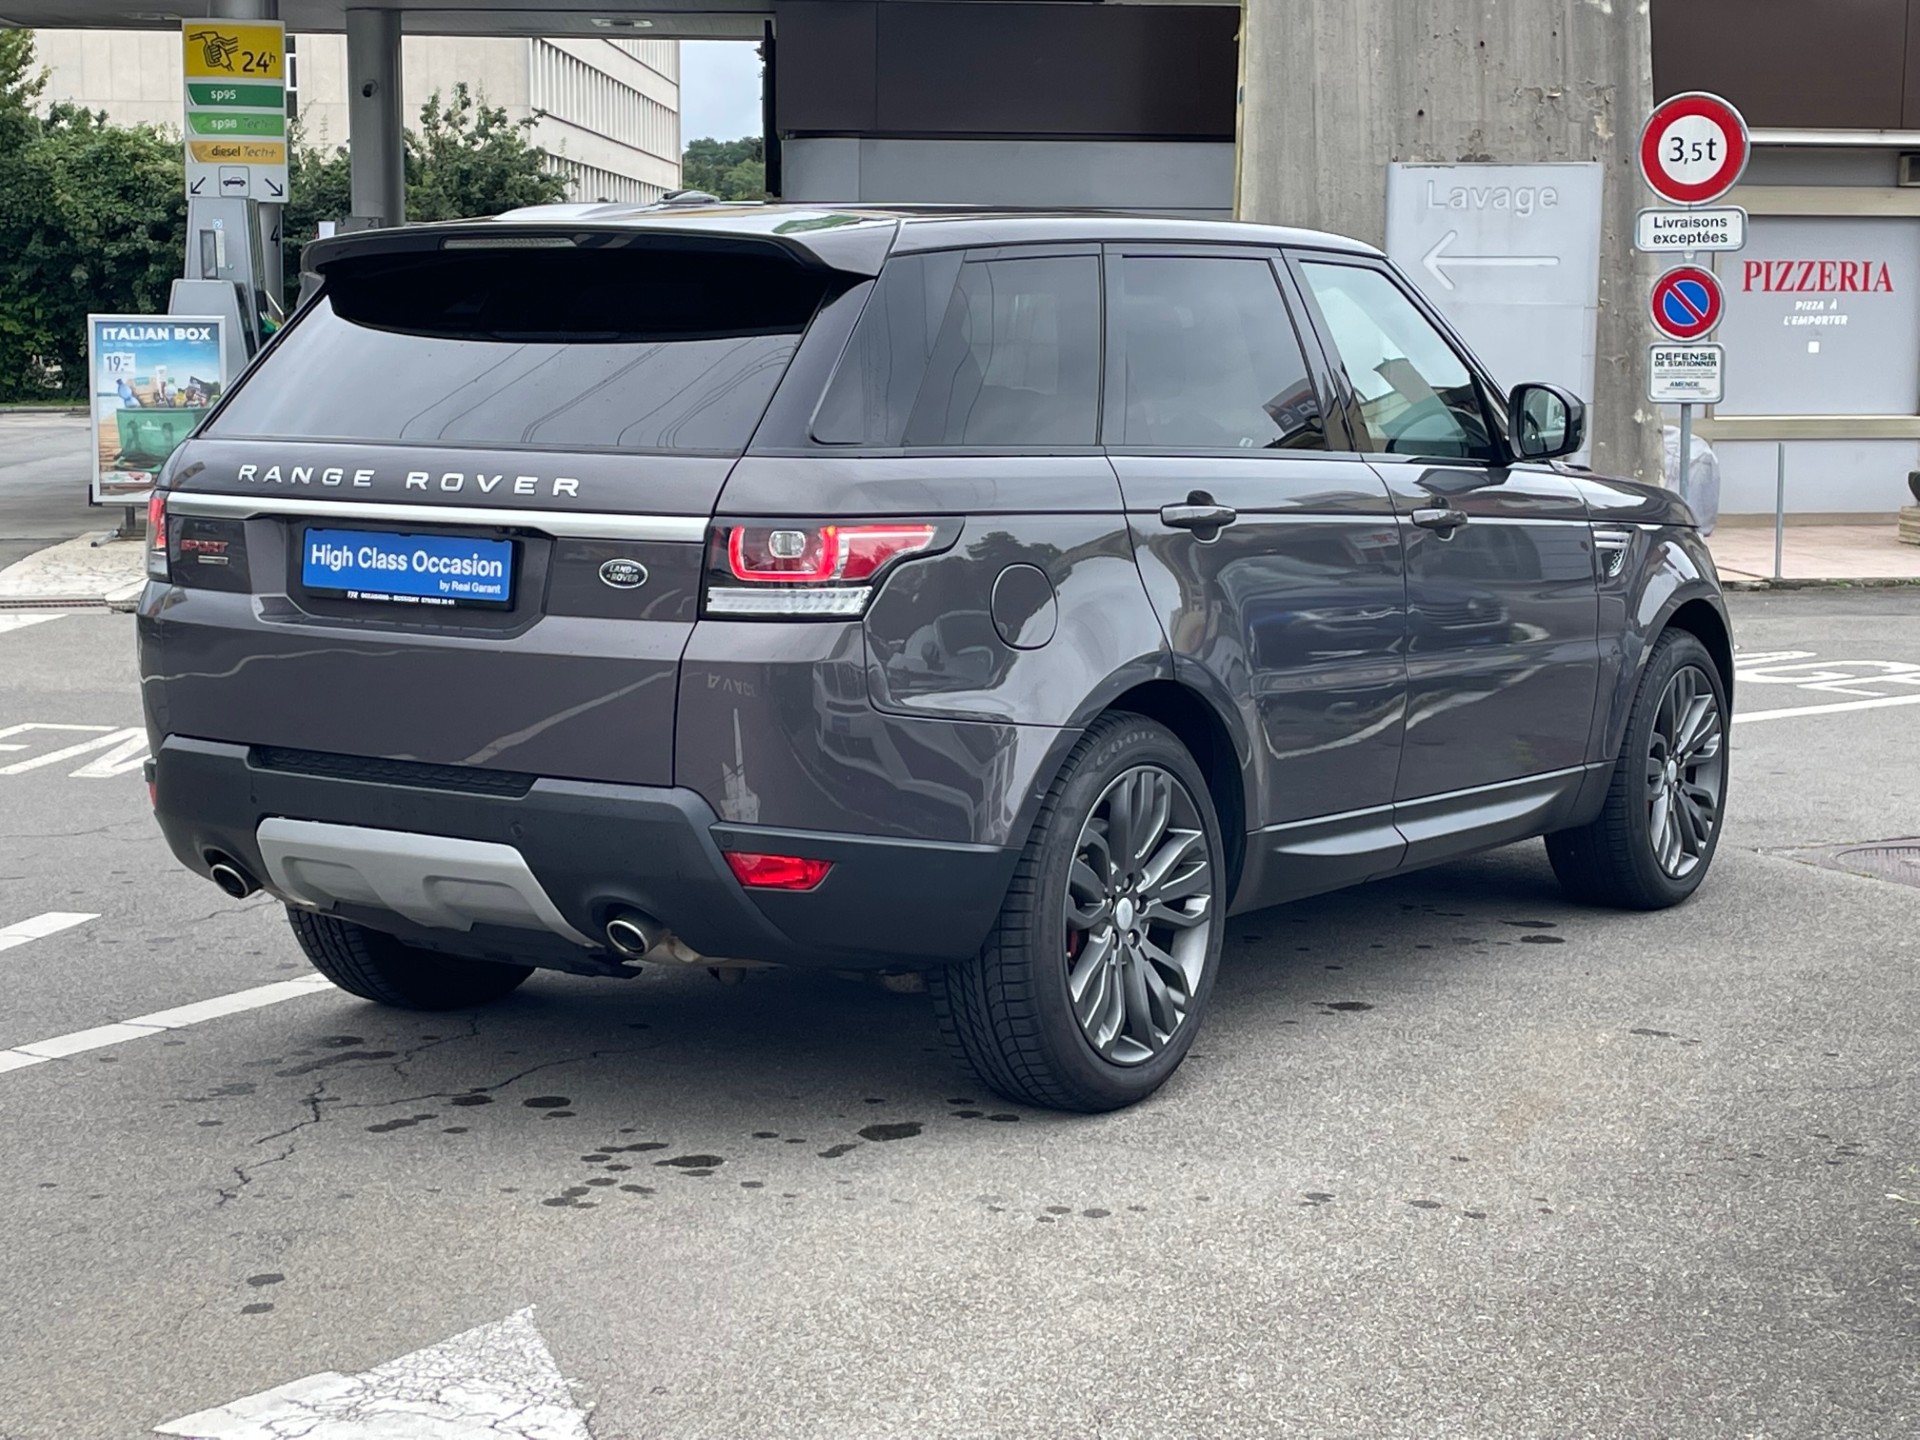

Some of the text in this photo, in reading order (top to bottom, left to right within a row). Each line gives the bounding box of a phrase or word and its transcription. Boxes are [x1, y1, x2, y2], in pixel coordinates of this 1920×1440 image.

[210, 89, 236, 101] sp95
[210, 118, 237, 130] sp98
[211, 145, 276, 158] diesel Tech+
[1426, 179, 1558, 218] Lavage
[1653, 216, 1728, 229] Livraisons
[270, 224, 281, 248] 4
[1653, 230, 1729, 246] exceptées
[1742, 260, 1894, 293] PIZZERIA
[1795, 301, 1824, 311] PIZZA
[1783, 315, 1849, 326] L'EMPORTER
[102, 327, 211, 341] ITALIAN BOX
[237, 463, 581, 497] RANGE ROVER
[180, 539, 229, 553] SPORT
[311, 544, 502, 577] High Class Occasion
[439, 580, 502, 594] by Real Garant
